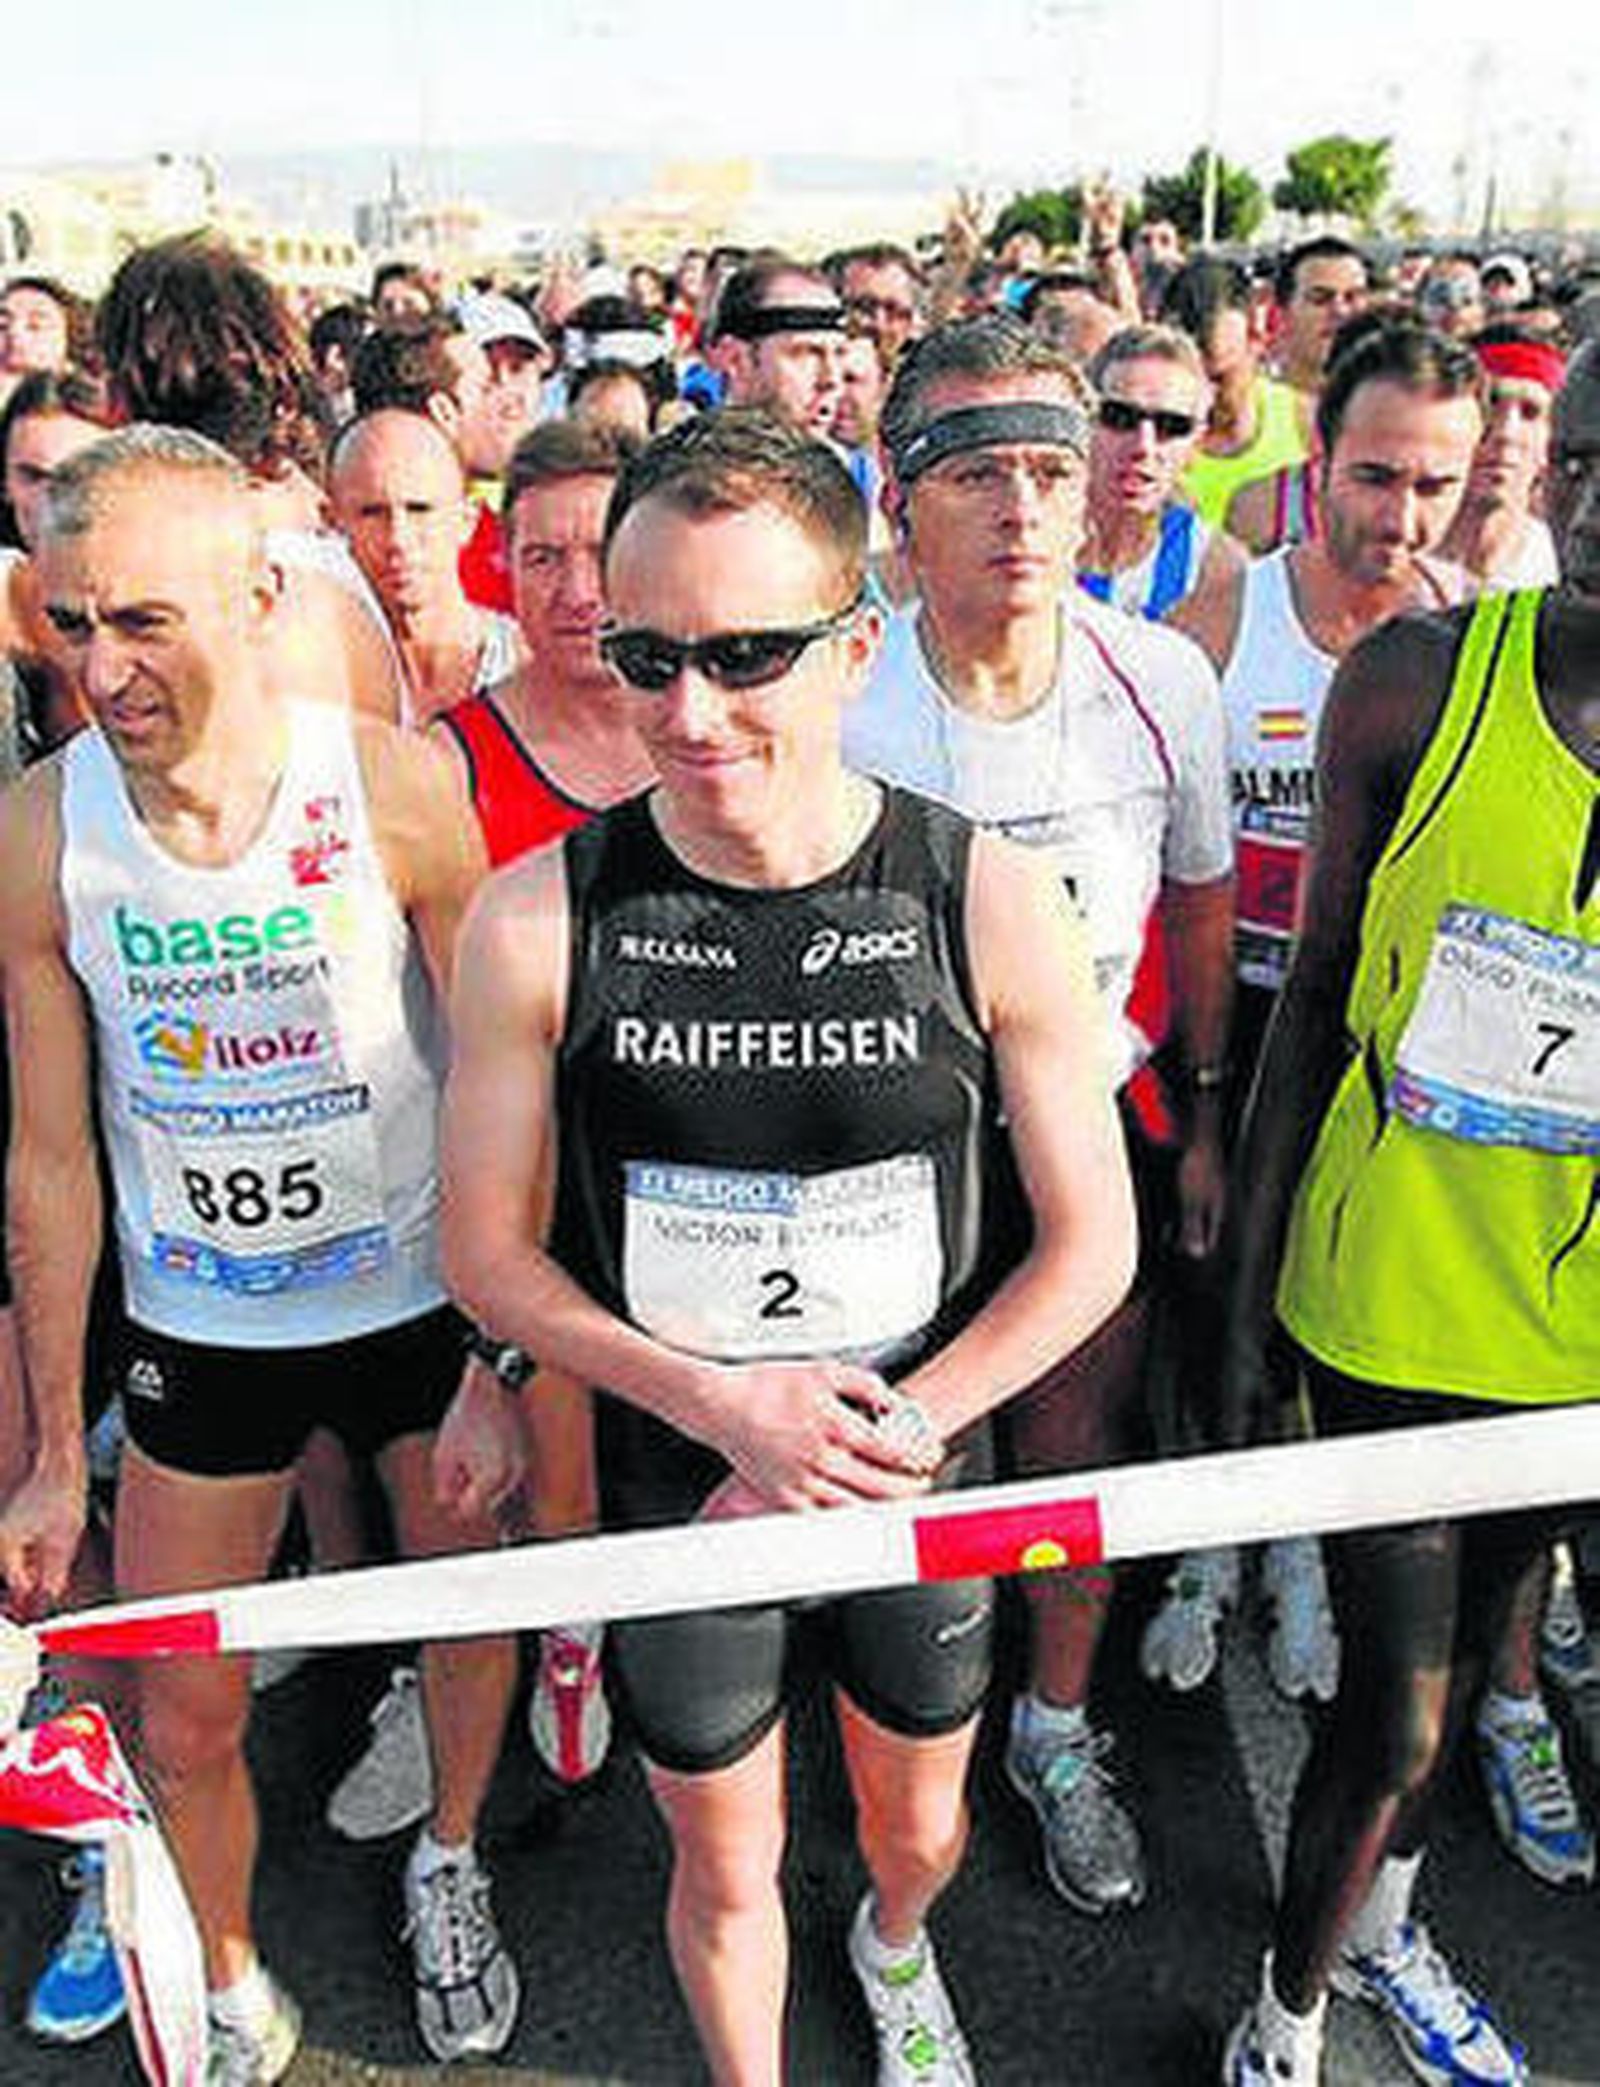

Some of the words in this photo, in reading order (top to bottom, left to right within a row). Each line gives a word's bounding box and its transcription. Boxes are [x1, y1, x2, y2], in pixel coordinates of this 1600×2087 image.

[115, 906, 314, 966] base
[615, 1014, 918, 1068] RAIFFEISEN
[1531, 1022, 1576, 1076] 7
[181, 1161, 322, 1228] 885
[758, 1270, 803, 1319] 2
